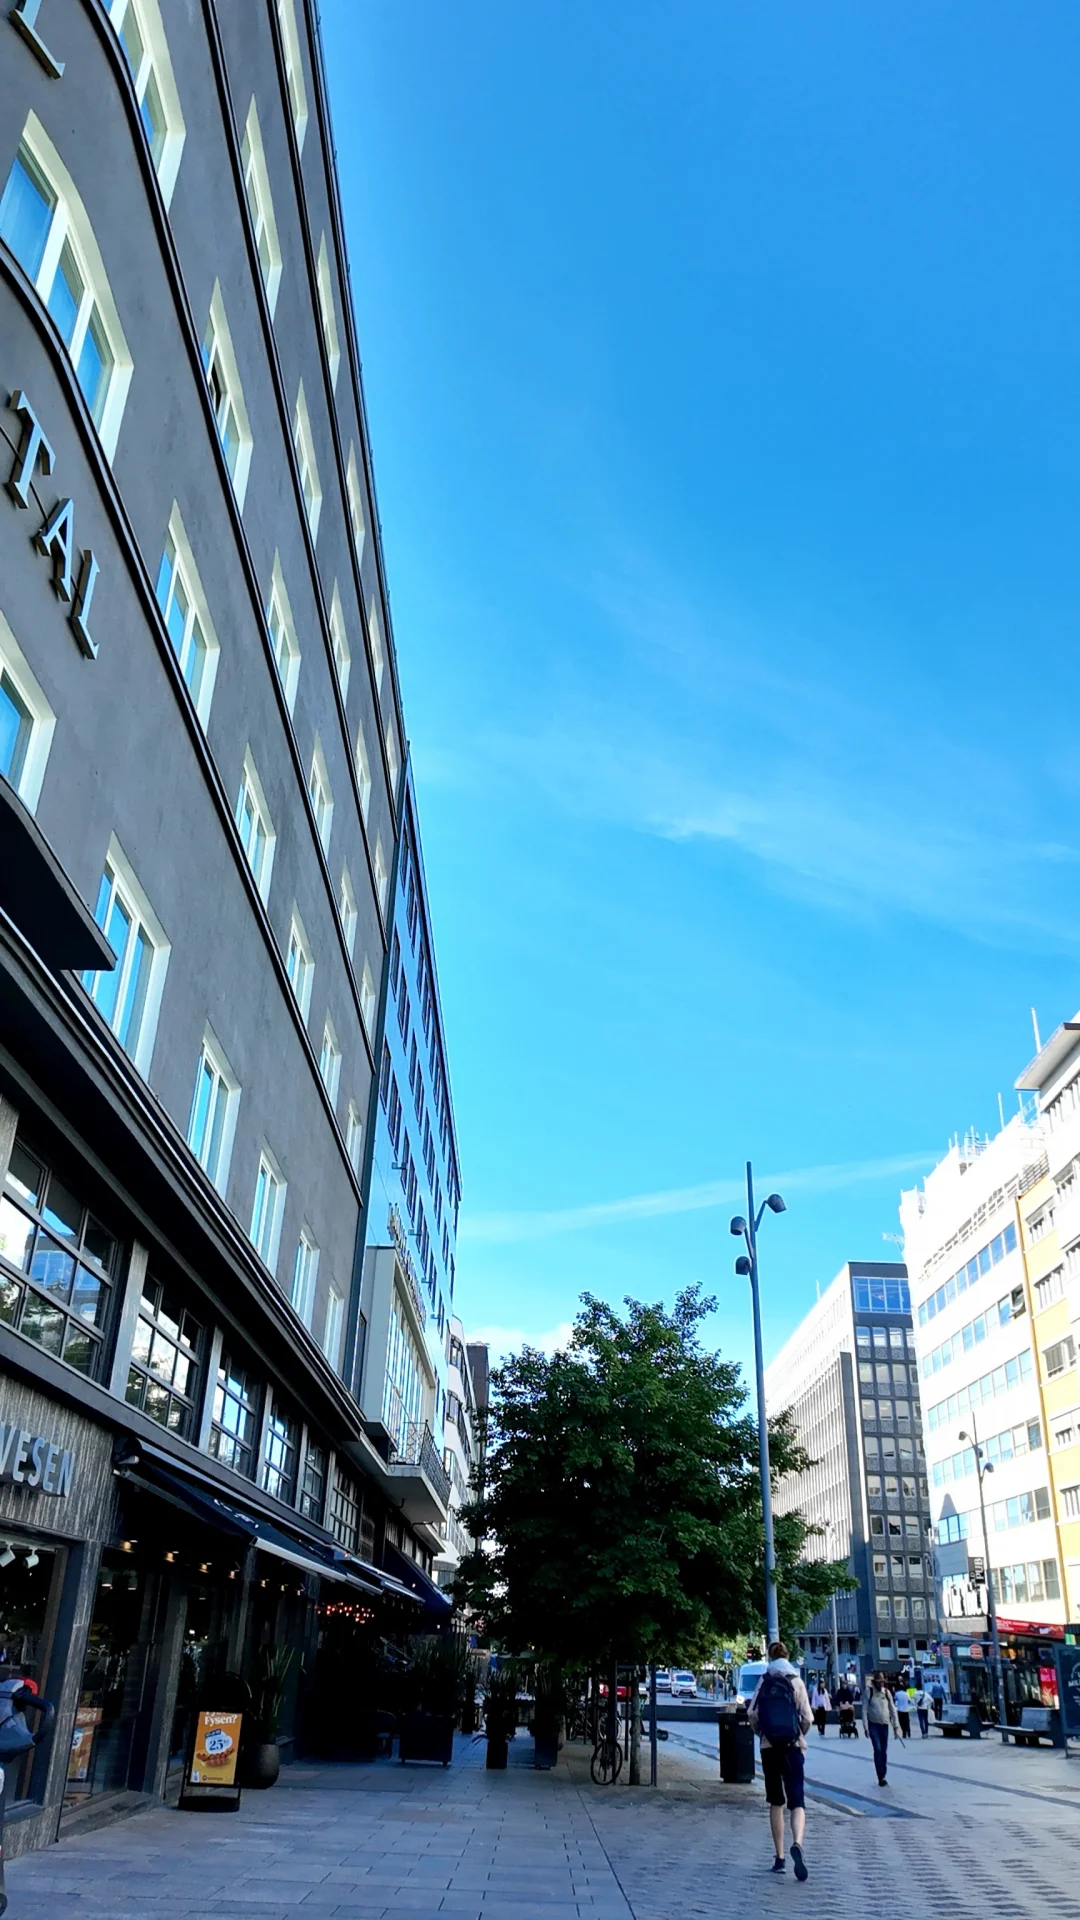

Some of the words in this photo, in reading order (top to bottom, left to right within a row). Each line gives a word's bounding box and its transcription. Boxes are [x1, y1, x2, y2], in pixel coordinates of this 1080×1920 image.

[974, 1557, 984, 1580] PUB
[204, 1715, 238, 1727] Fysen?
[210, 1740, 224, 1751] 25
